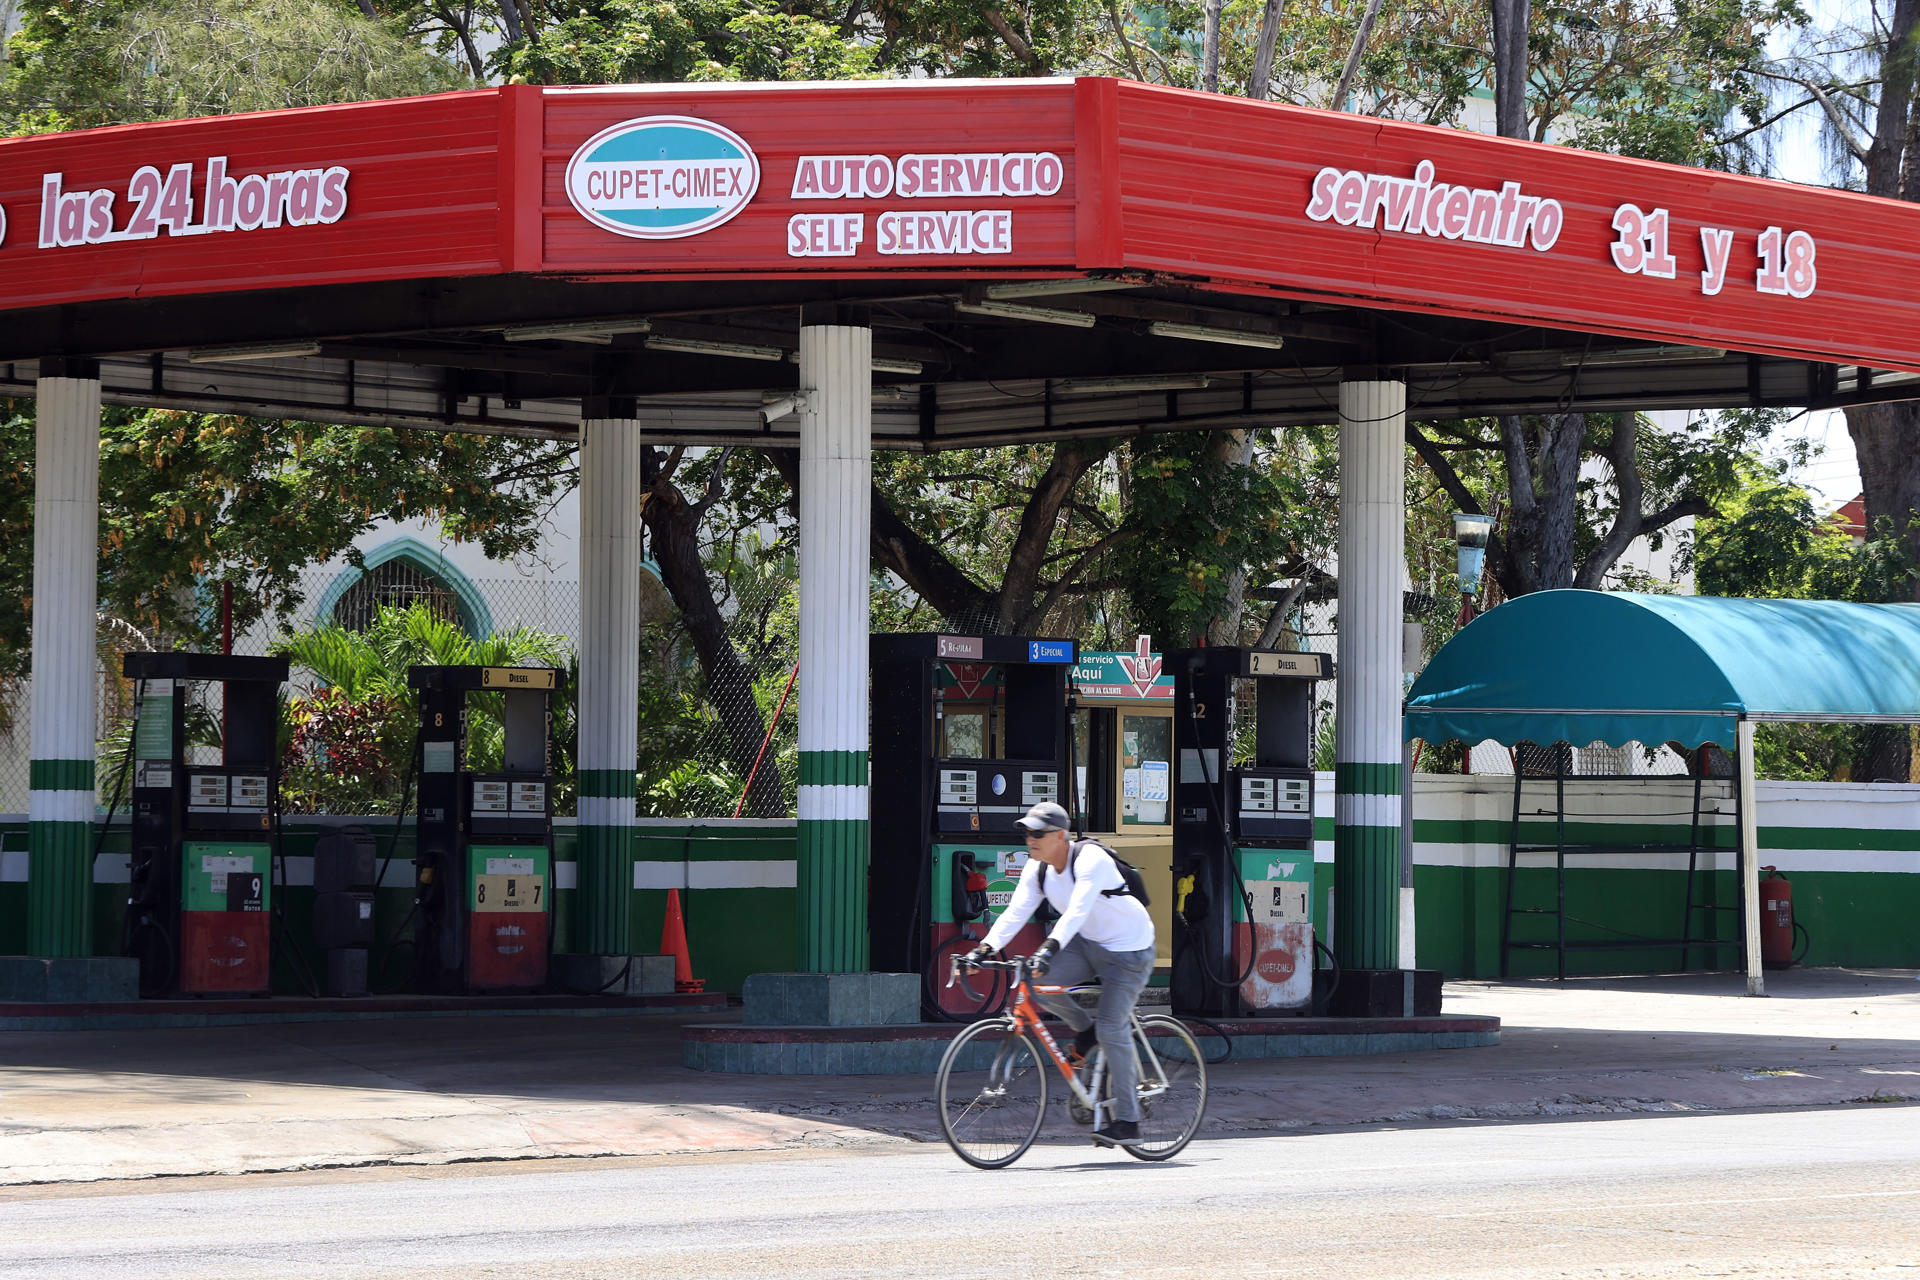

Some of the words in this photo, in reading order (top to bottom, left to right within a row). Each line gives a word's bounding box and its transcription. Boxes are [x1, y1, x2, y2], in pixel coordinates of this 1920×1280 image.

[587, 167, 744, 201] CUPET-CIMEX
[792, 156, 894, 198] AUTO
[897, 152, 1063, 198] SERVICIO
[38, 173, 115, 248] las
[128, 163, 193, 237] 24
[206, 156, 350, 232] horas
[788, 213, 864, 256] SELF
[877, 210, 1012, 254] SERVICE
[1305, 160, 1563, 252] servicentro
[1610, 203, 1676, 279] 31
[1701, 227, 1734, 296] y
[1756, 226, 1816, 298] 18
[940, 639, 947, 656] 5
[1032, 642, 1039, 660] 3
[1041, 646, 1063, 657] ESPECIAL
[1083, 655, 1114, 664] servicio
[1253, 655, 1259, 671] 2
[1278, 660, 1297, 670] DIESEL
[1314, 658, 1319, 673] 1
[484, 670, 490, 684] 8
[509, 673, 528, 683] DIESEL
[548, 673, 553, 687] 7
[1071, 666, 1102, 681] Aquí
[434, 712, 443, 727] 8
[1196, 703, 1206, 719] 2
[251, 877, 261, 898] 9
[478, 883, 486, 903] 8
[534, 885, 541, 904] 7
[1300, 893, 1305, 914] 1
